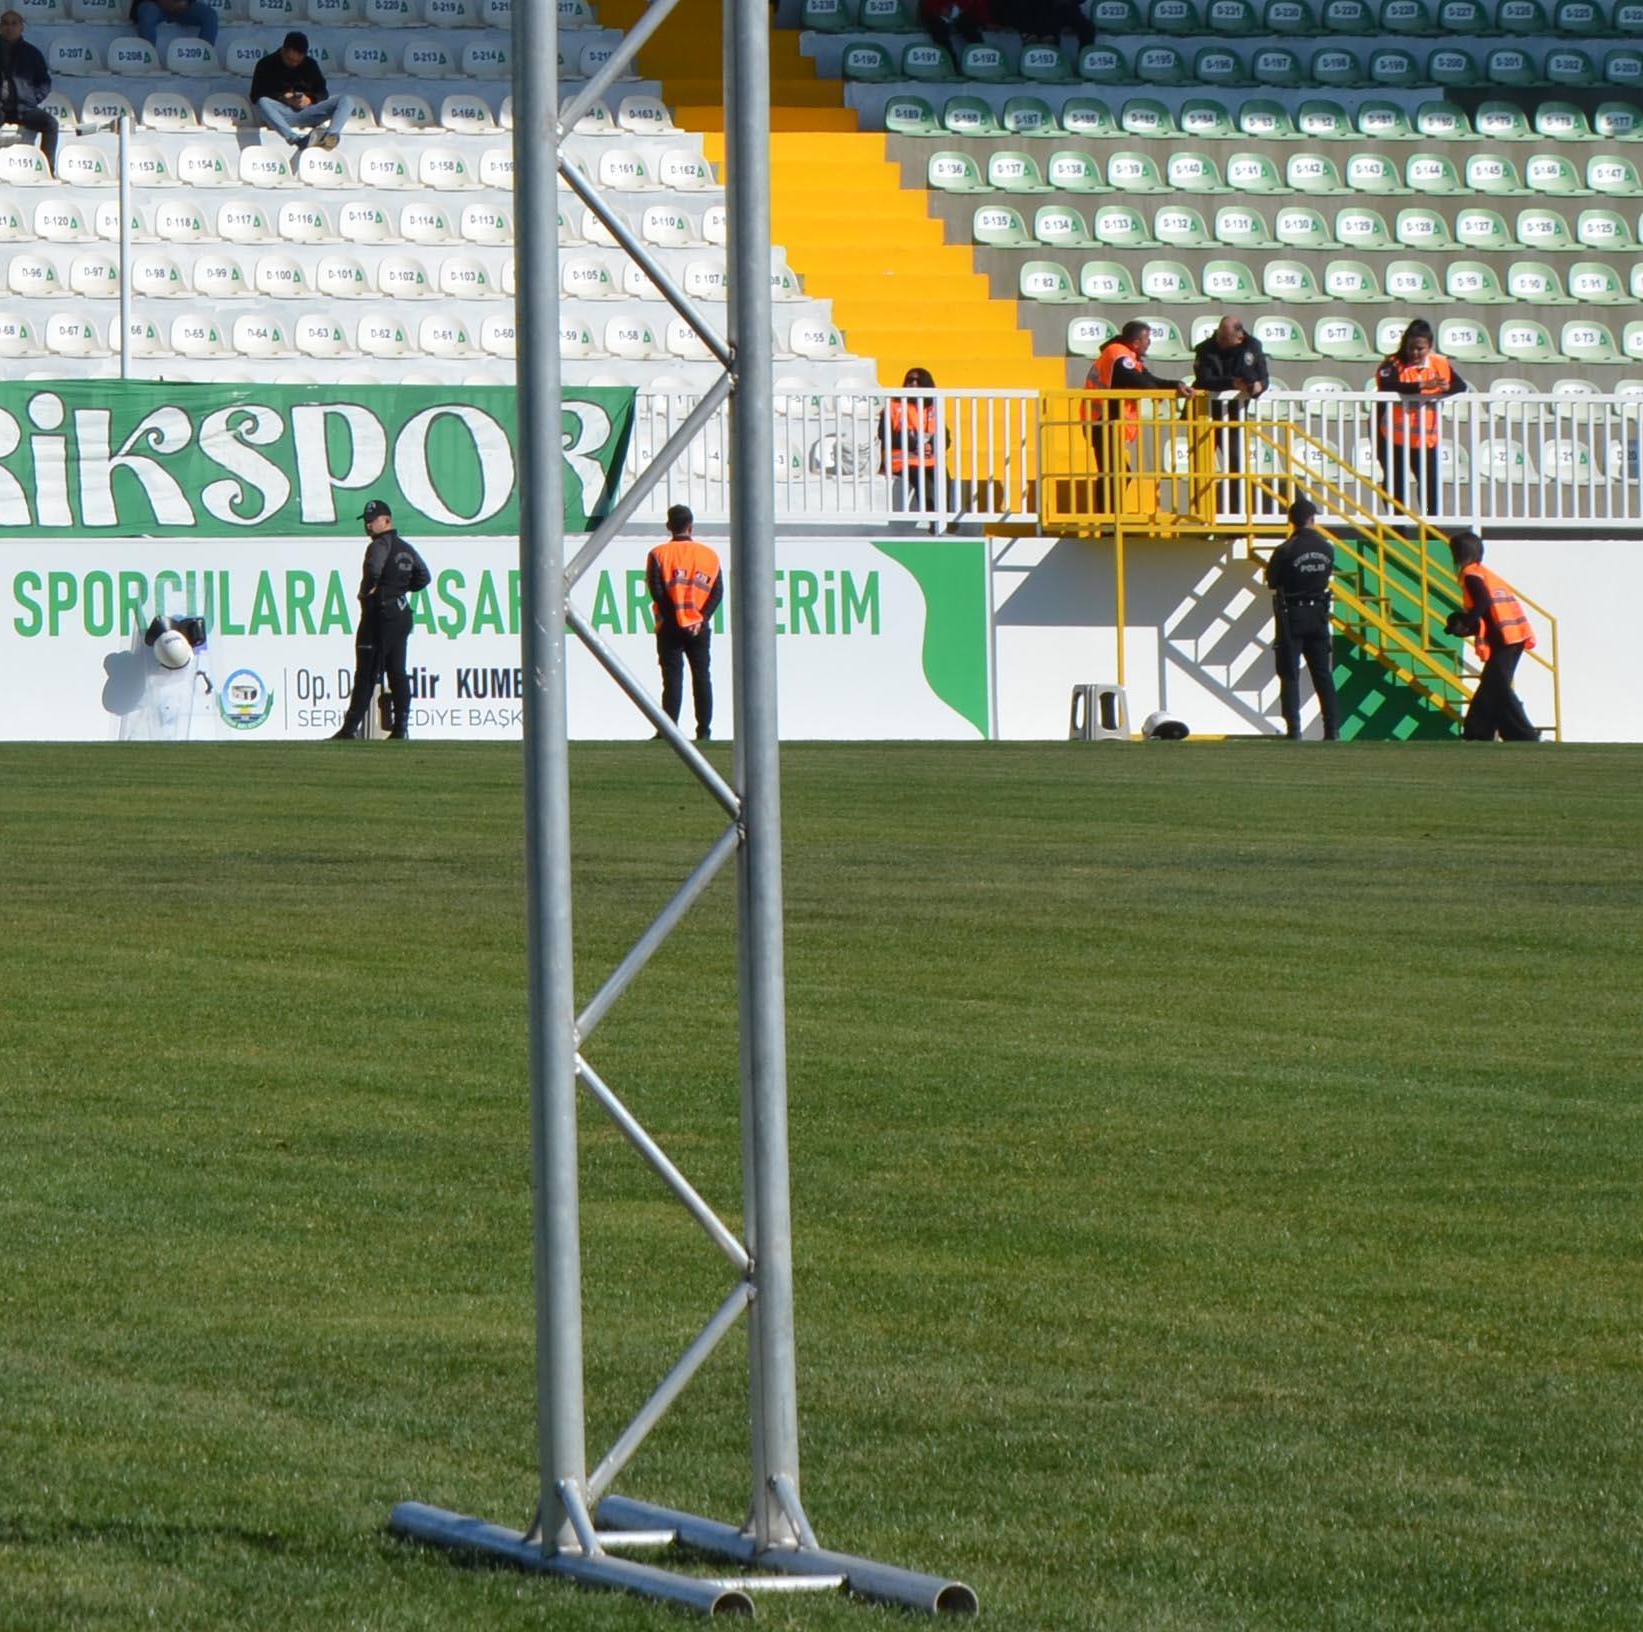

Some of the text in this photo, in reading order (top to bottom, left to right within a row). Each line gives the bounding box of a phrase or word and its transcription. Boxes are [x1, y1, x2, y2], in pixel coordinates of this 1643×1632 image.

[176, 48, 202, 59] D-209
[153, 106, 179, 118] D-171
[451, 108, 477, 119] D-166
[409, 216, 435, 226] D-114
[469, 214, 496, 226] D-113
[981, 216, 1007, 227] D-135
[21, 268, 43, 279] D-96
[83, 266, 106, 278] D-97
[206, 268, 228, 279] D-99
[1264, 328, 1286, 338] D-78
[1326, 328, 1348, 339] D-77
[1572, 333, 1595, 344] D-73
[13, 569, 354, 638] SPORCULARA
[297, 668, 331, 707] Op.
